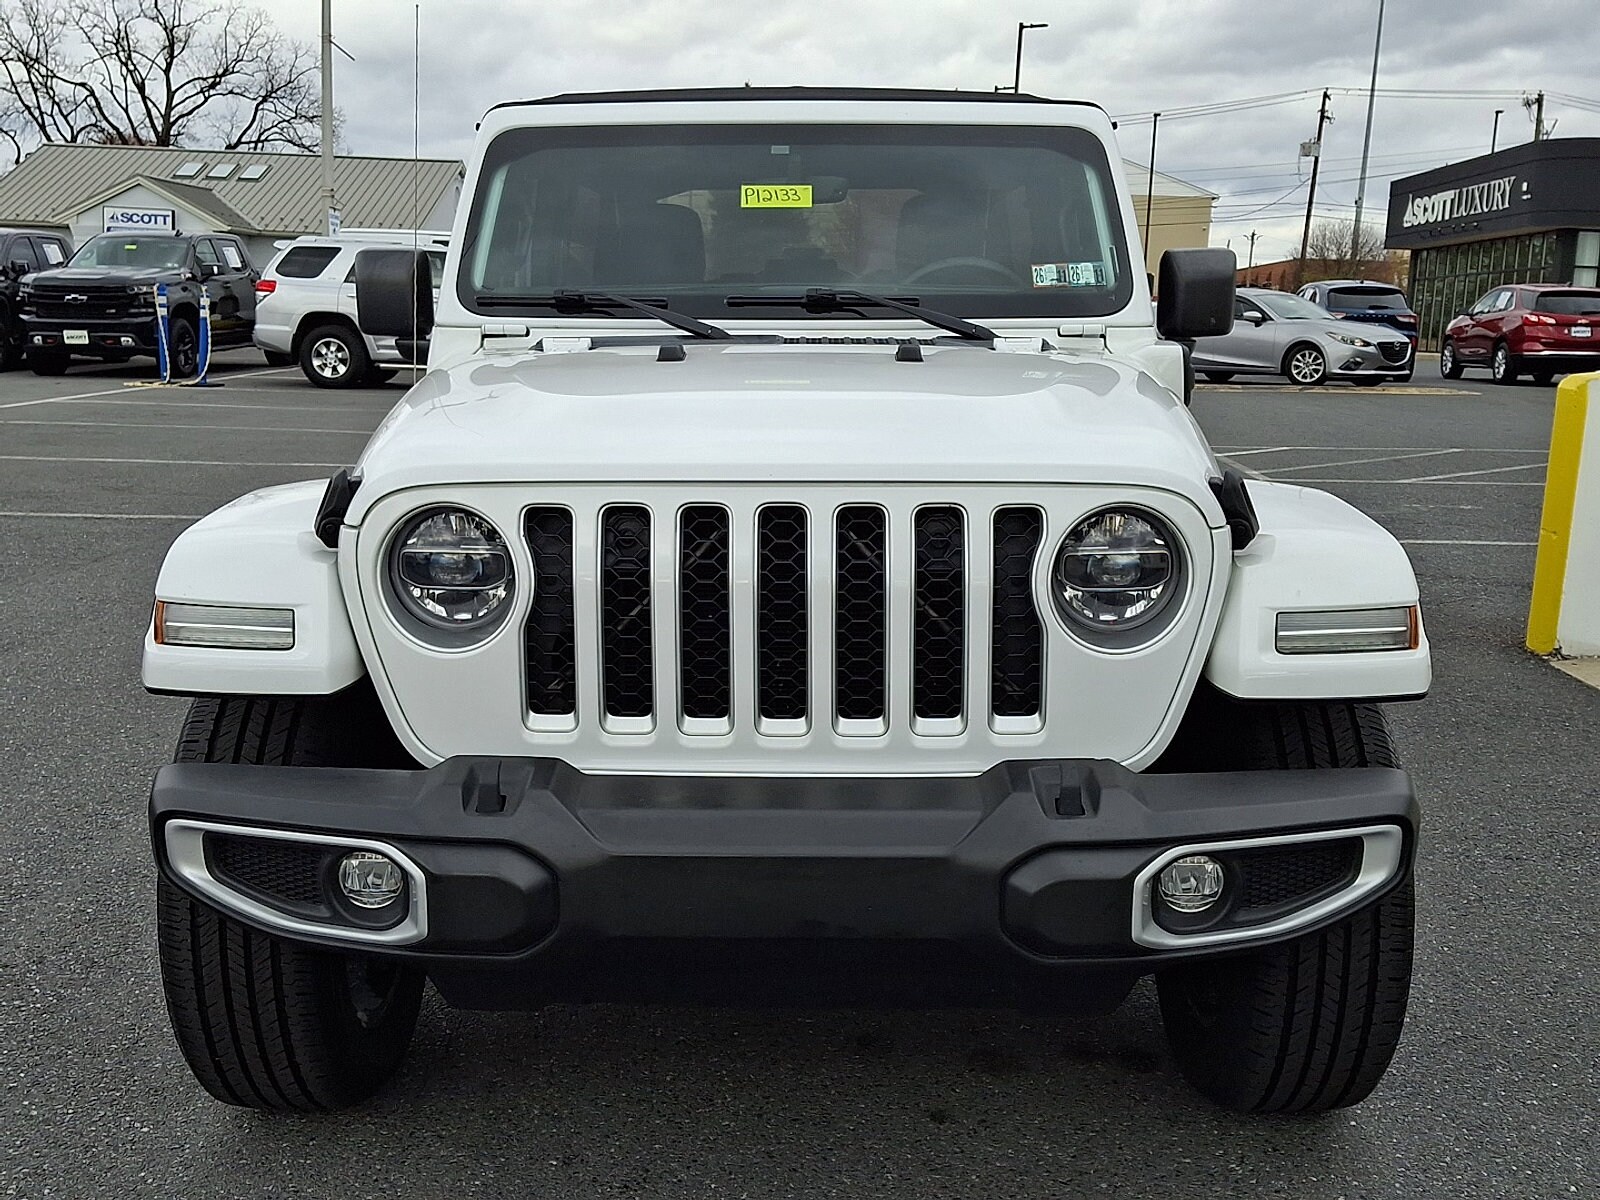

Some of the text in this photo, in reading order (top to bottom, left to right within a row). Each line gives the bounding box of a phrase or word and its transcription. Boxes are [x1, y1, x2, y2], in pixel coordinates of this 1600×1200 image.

[744, 187, 802, 205] P12133
[1452, 175, 1517, 218] LUXURY
[120, 212, 170, 226] SCOTT
[1034, 267, 1045, 284] 26
[1070, 265, 1081, 282] 26
